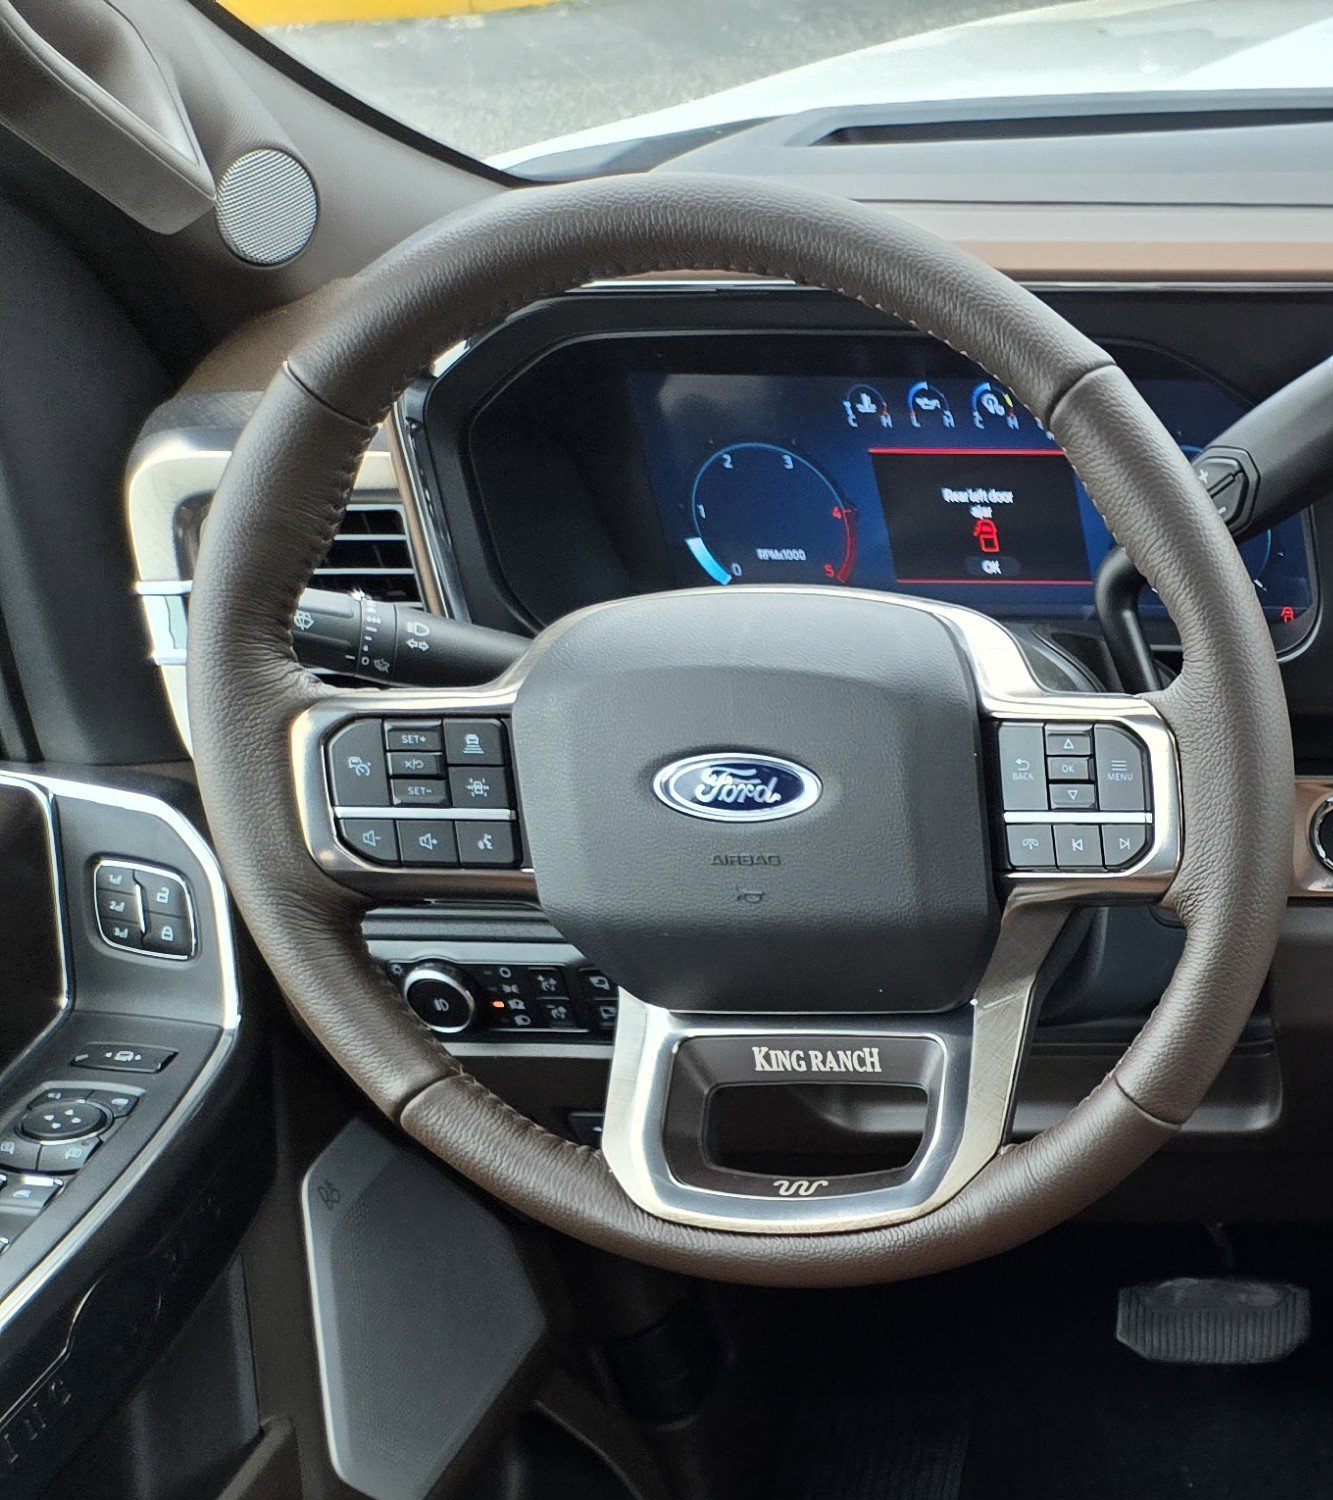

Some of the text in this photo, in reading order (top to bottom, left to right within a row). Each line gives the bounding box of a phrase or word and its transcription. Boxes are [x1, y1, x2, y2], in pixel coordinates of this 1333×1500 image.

[722, 454, 733, 469] 2
[782, 455, 793, 469] 3
[697, 504, 706, 518] 1
[1062, 765, 1075, 773] OK
[1108, 773, 1132, 781] MENU
[695, 767, 782, 804] Ford
[711, 855, 781, 866] AIRBAG
[752, 1046, 882, 1072] KING RANCH
